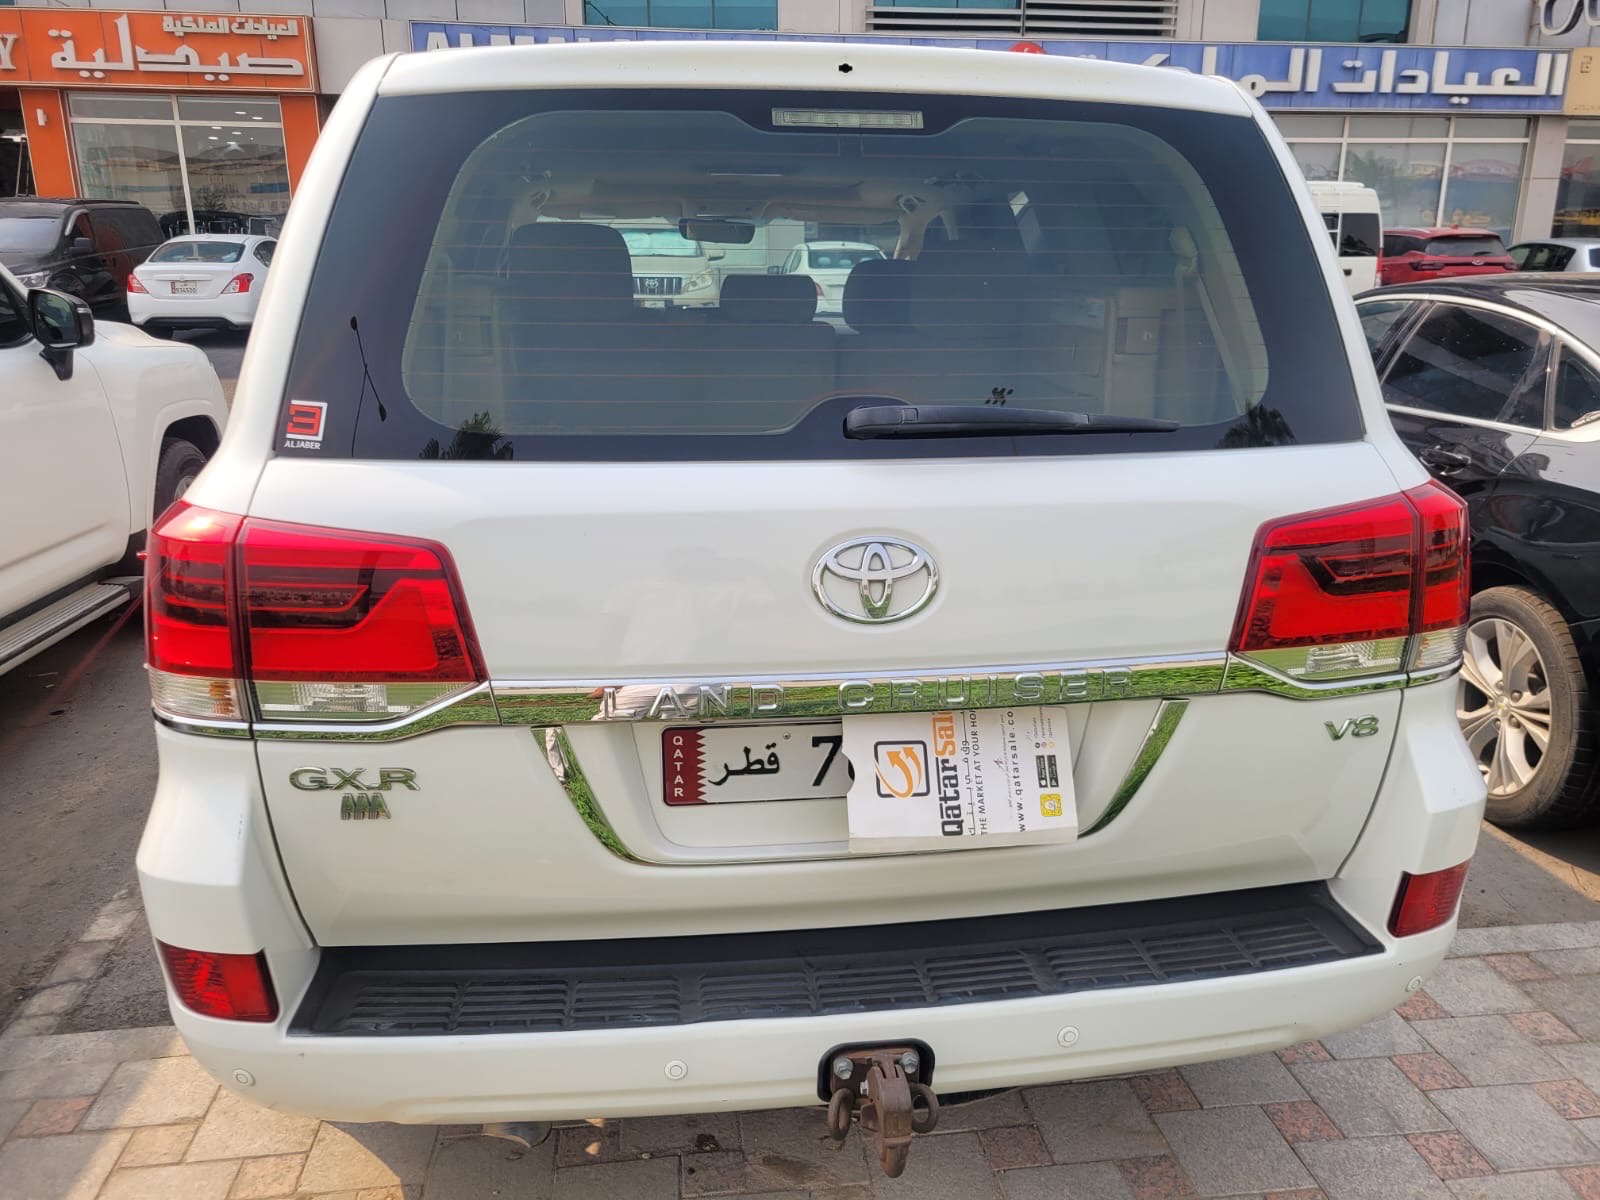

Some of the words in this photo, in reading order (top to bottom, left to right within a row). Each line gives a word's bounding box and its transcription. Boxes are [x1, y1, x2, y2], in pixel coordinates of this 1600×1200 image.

[48, 13, 305, 82] صيدلية
[162, 15, 230, 37] الملكية
[1331, 50, 1568, 105] العيادات
[284, 440, 321, 450] ALJABER
[603, 684, 785, 720] LAND
[838, 667, 1132, 712] CRUISER
[971, 729, 981, 757] YOUR
[1323, 714, 1379, 741] V8
[289, 766, 421, 792] GXR
[672, 735, 684, 797] QATAR
[707, 742, 780, 786] قطر
[812, 735, 855, 786] 7
[932, 711, 964, 837] QatarSal
[974, 758, 982, 771] AT
[975, 772, 987, 815] MARKET
[979, 817, 989, 836] THE
